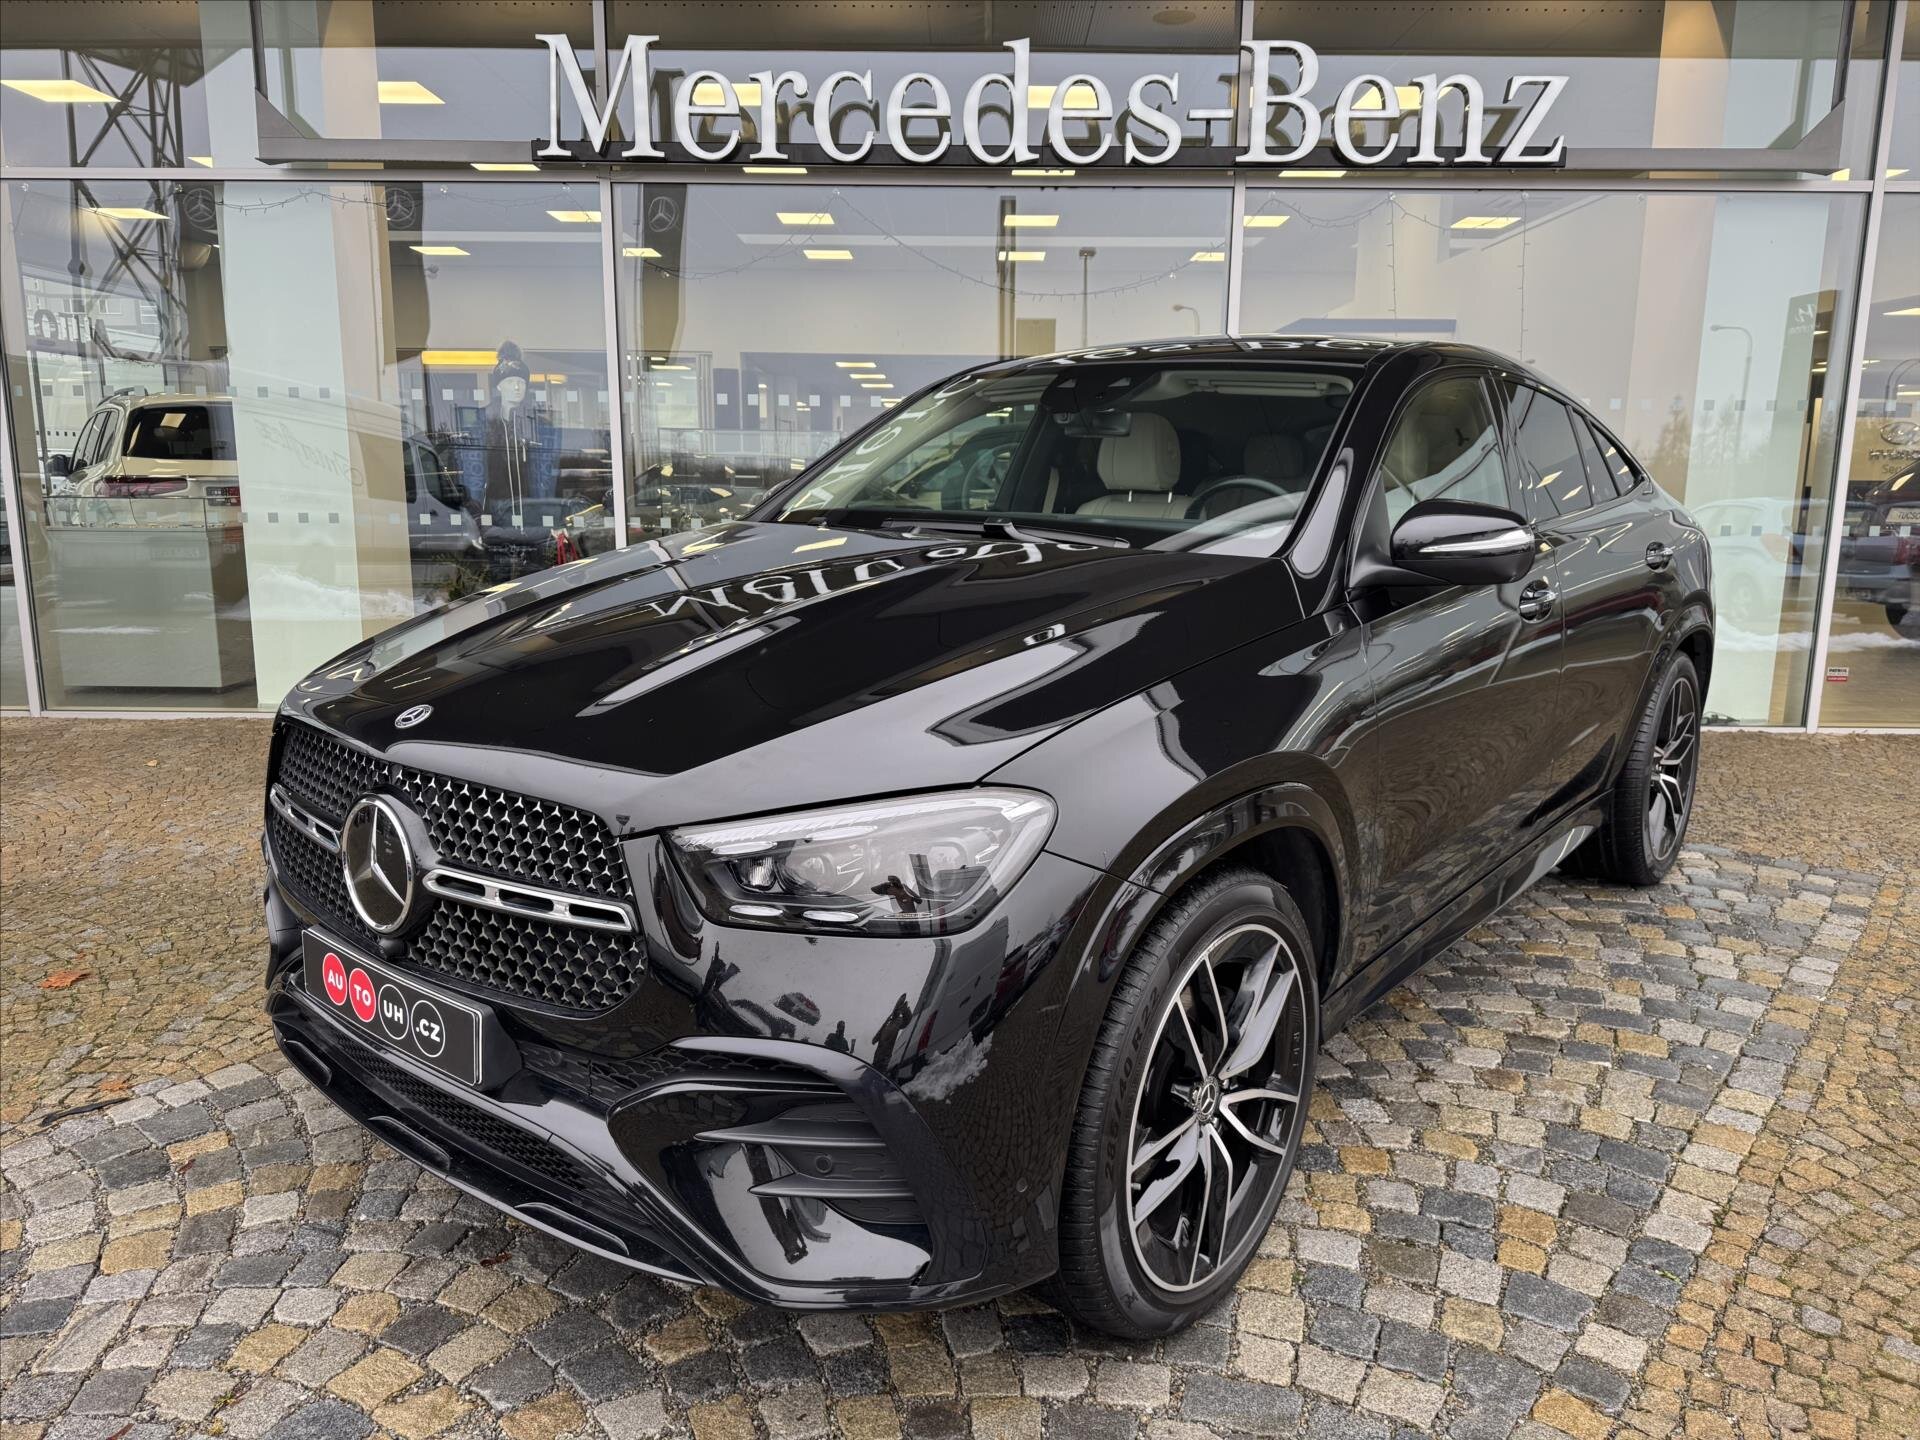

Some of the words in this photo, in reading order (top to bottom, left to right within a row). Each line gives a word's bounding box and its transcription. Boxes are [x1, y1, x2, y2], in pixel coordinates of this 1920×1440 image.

[535, 33, 1570, 166] Mercedes-Benz
[327, 969, 343, 991] AU
[353, 984, 371, 1007] TO
[383, 999, 404, 1025] UH
